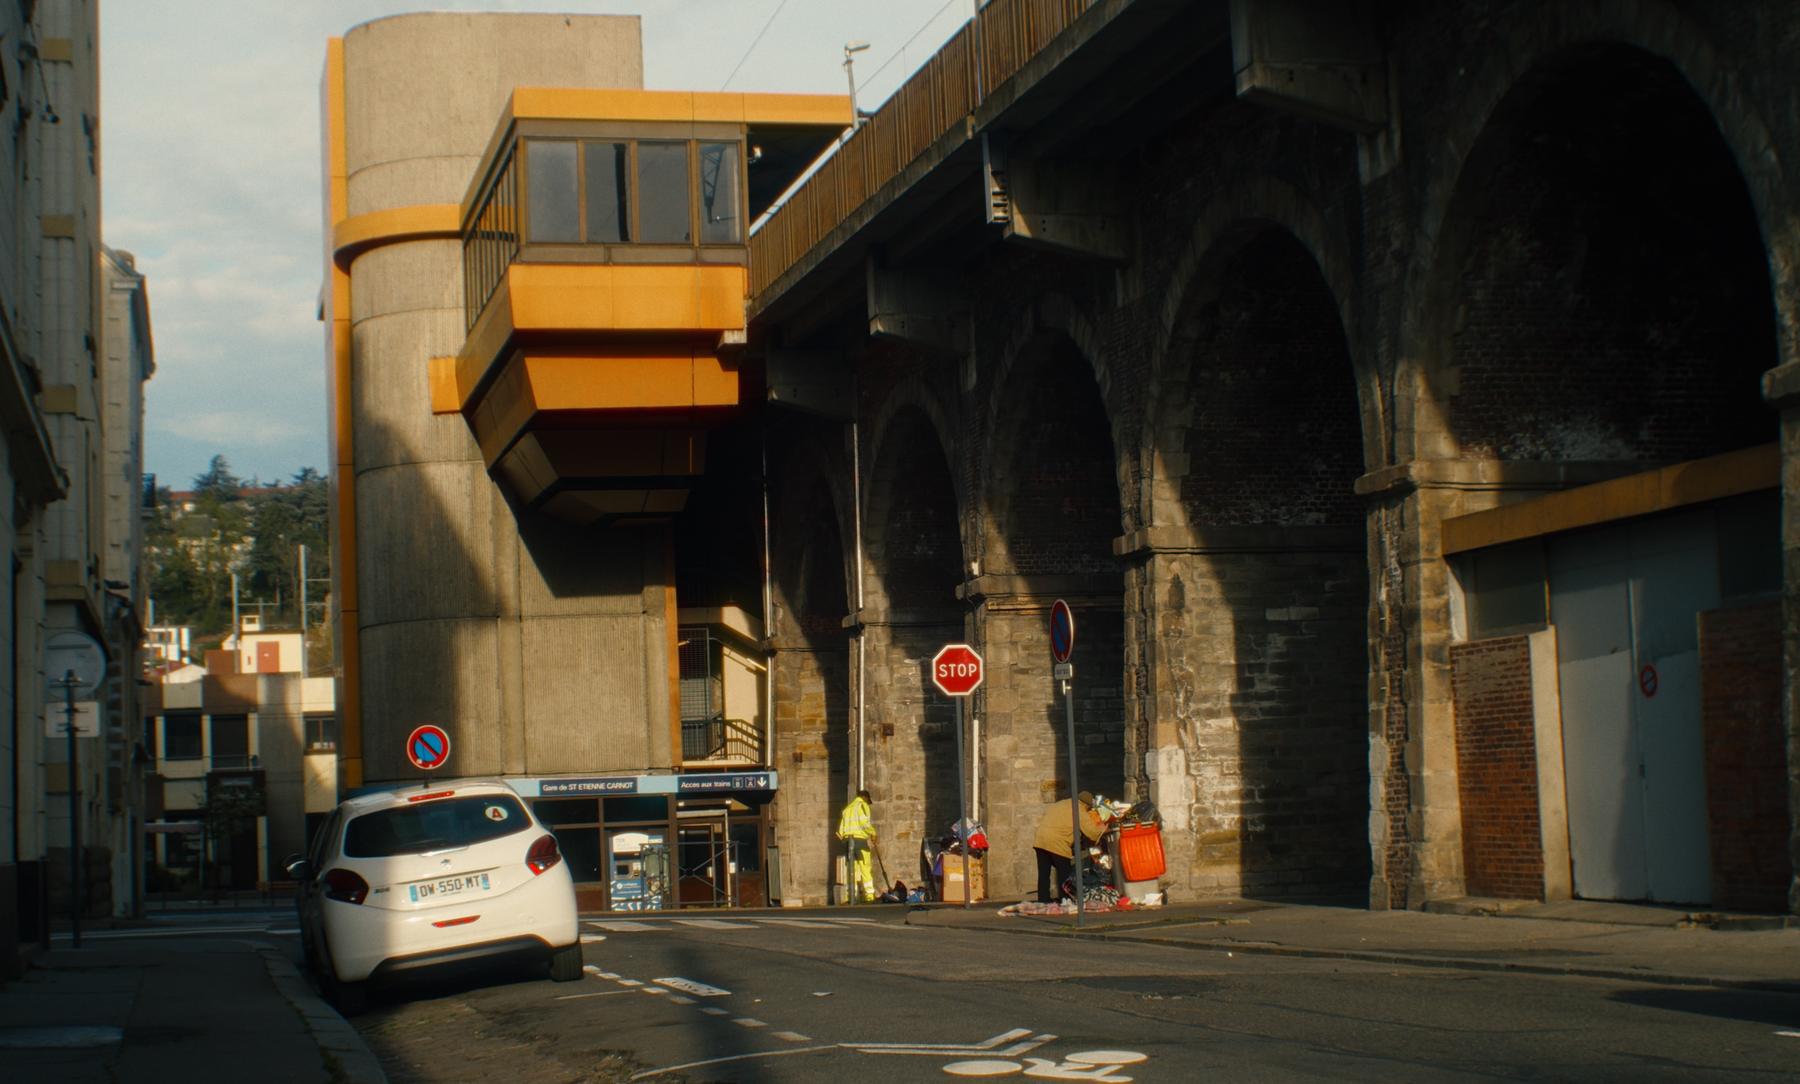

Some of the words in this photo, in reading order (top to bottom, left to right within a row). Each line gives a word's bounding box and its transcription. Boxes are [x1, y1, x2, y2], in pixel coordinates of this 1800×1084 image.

[938, 663, 977, 678] STOP
[542, 784, 558, 792] Gare
[558, 784, 568, 792] de
[568, 783, 577, 791] ST
[578, 782, 606, 791] ETIENNE
[492, 807, 503, 819] A
